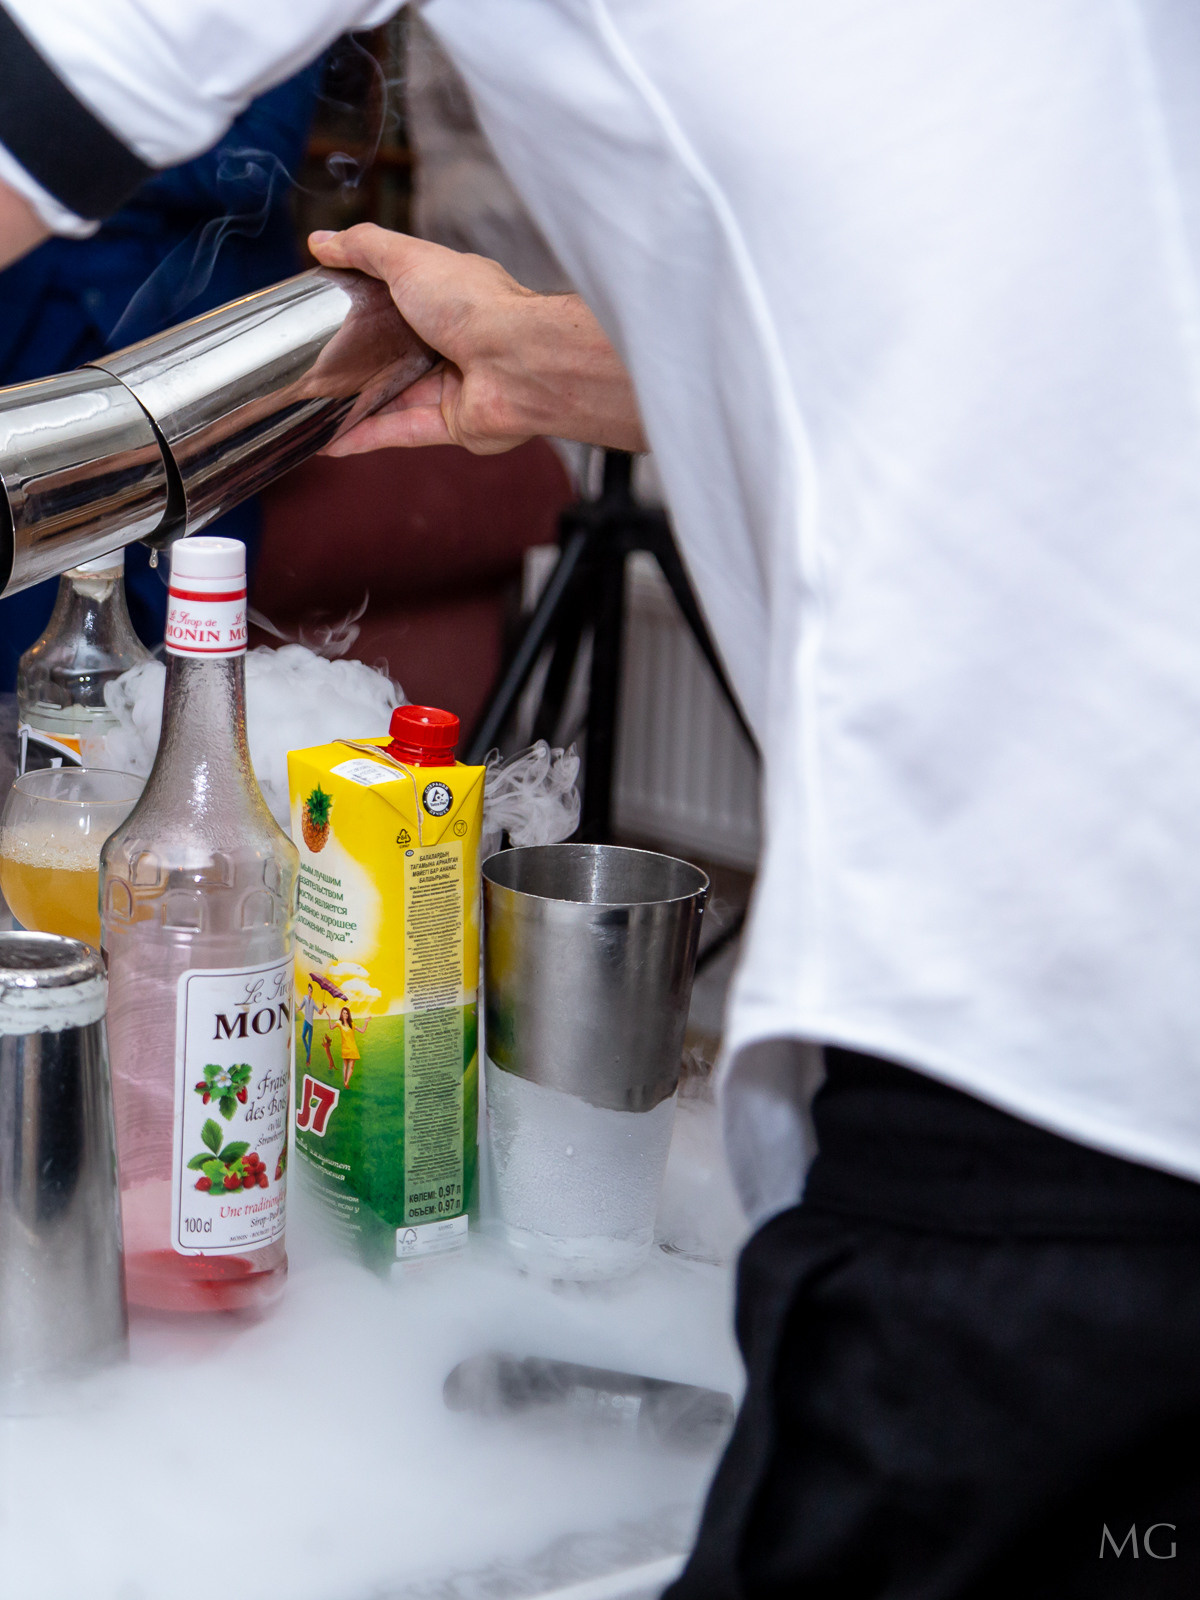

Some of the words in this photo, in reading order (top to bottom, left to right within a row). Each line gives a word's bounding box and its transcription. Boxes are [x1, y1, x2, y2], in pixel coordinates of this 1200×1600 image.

[177, 611, 202, 629] Sirop
[167, 623, 220, 642] MONIN
[313, 869, 341, 887] лучшим
[315, 896, 348, 915] является
[321, 913, 357, 930] хорошее
[234, 979, 264, 1006] Le
[245, 1101, 265, 1121] des
[296, 1074, 340, 1137] J7
[438, 1184, 455, 1199] 0,97
[220, 1206, 242, 1218] Une
[409, 1205, 437, 1217] ОБЪЕМ:
[438, 1199, 455, 1213] 0,97
